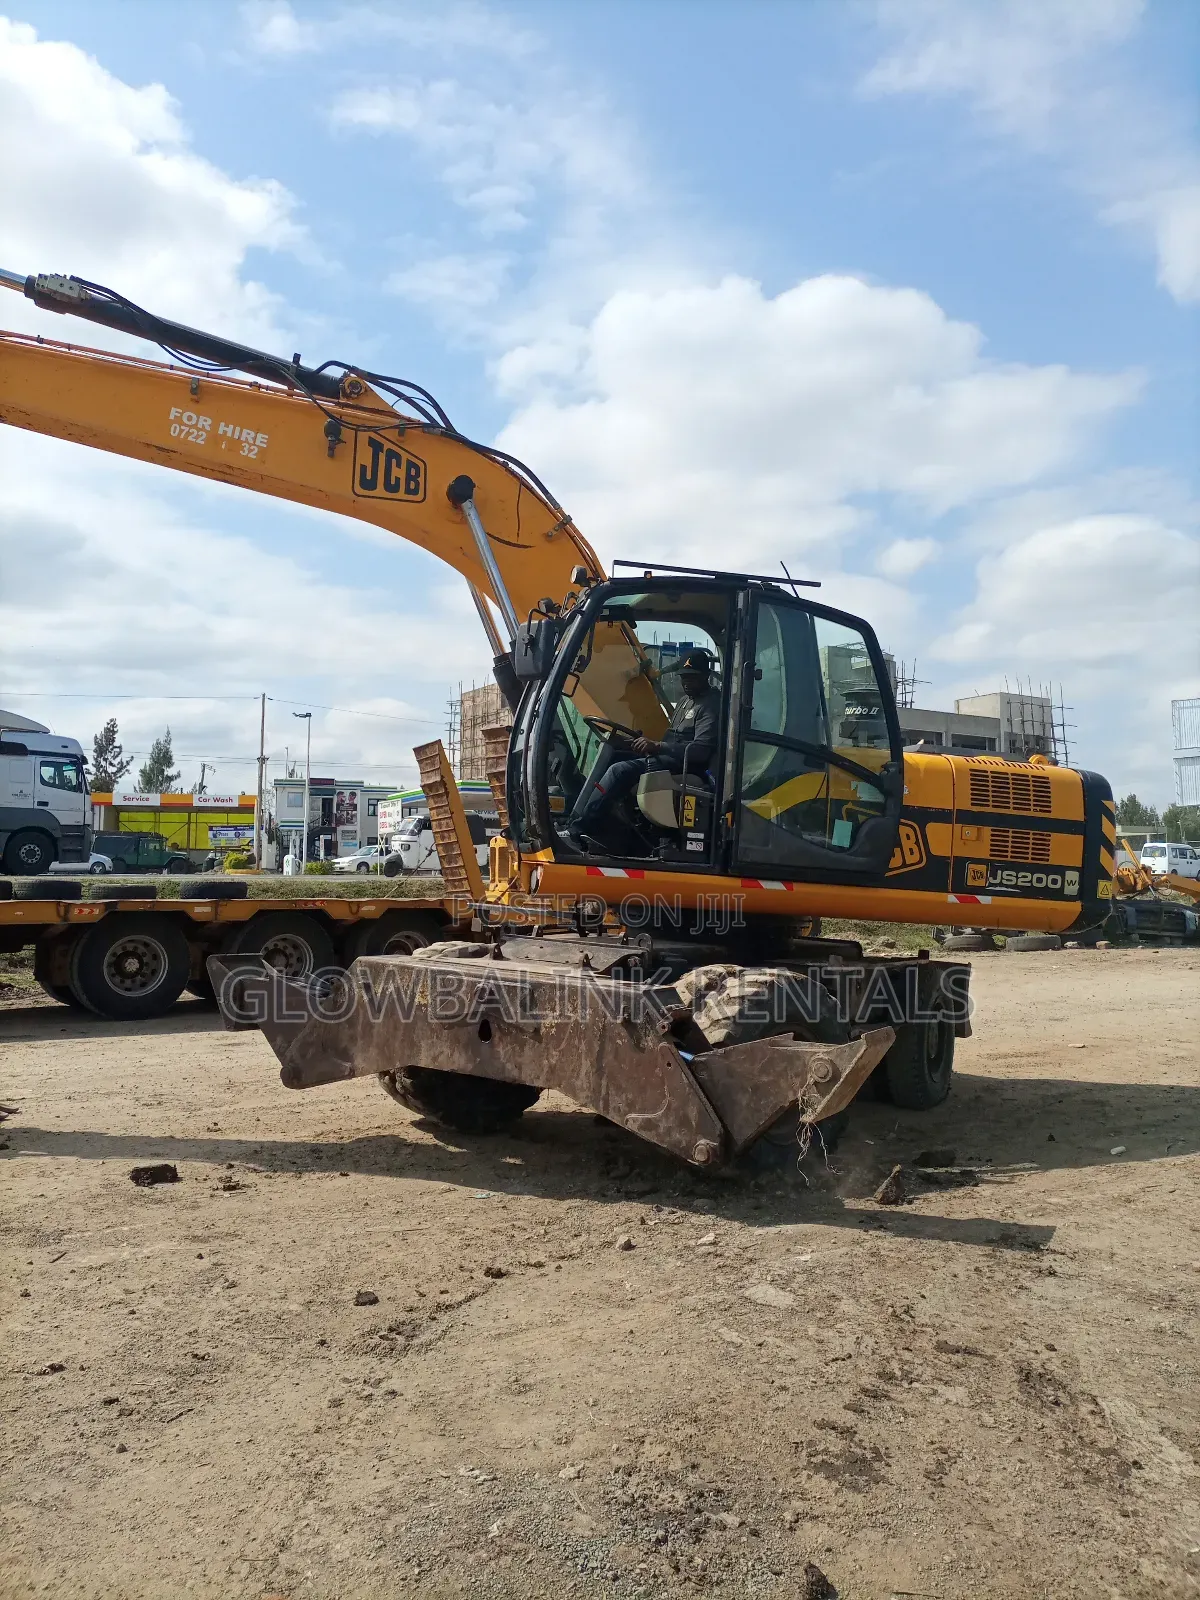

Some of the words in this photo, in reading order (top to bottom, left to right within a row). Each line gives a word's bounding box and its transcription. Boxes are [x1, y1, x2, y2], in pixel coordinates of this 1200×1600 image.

[169, 407, 212, 431] FOR
[218, 422, 269, 448] HIRE
[170, 423, 207, 445] 0722
[359, 435, 421, 497] JCB
[988, 870, 1062, 889] JS200
